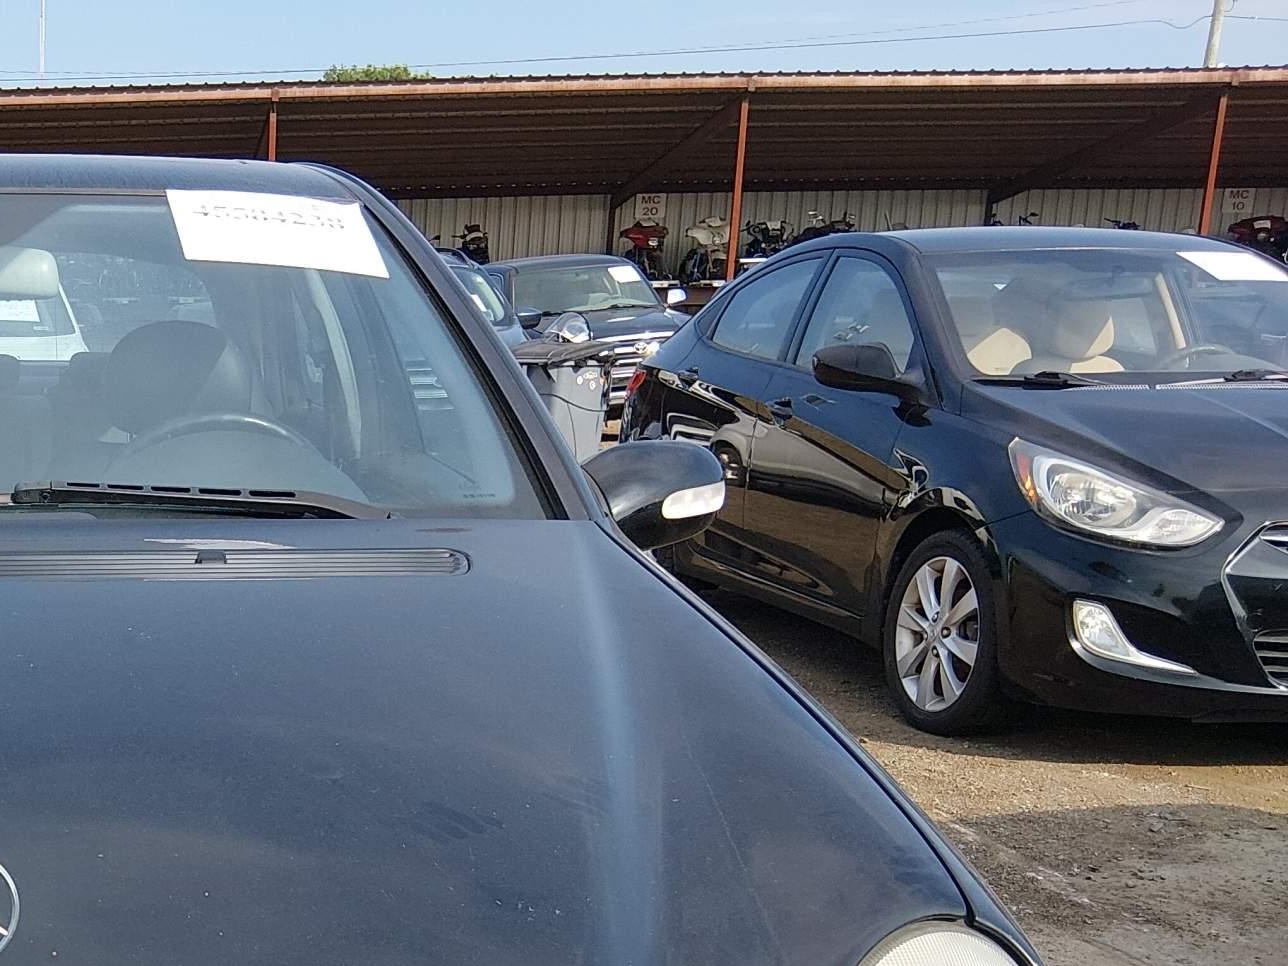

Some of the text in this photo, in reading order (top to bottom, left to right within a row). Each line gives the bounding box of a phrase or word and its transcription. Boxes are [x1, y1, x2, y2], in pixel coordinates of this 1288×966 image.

[1229, 190, 1249, 199] MC
[641, 195, 661, 204] MC
[1232, 201, 1245, 210] 10
[642, 206, 658, 216] 20
